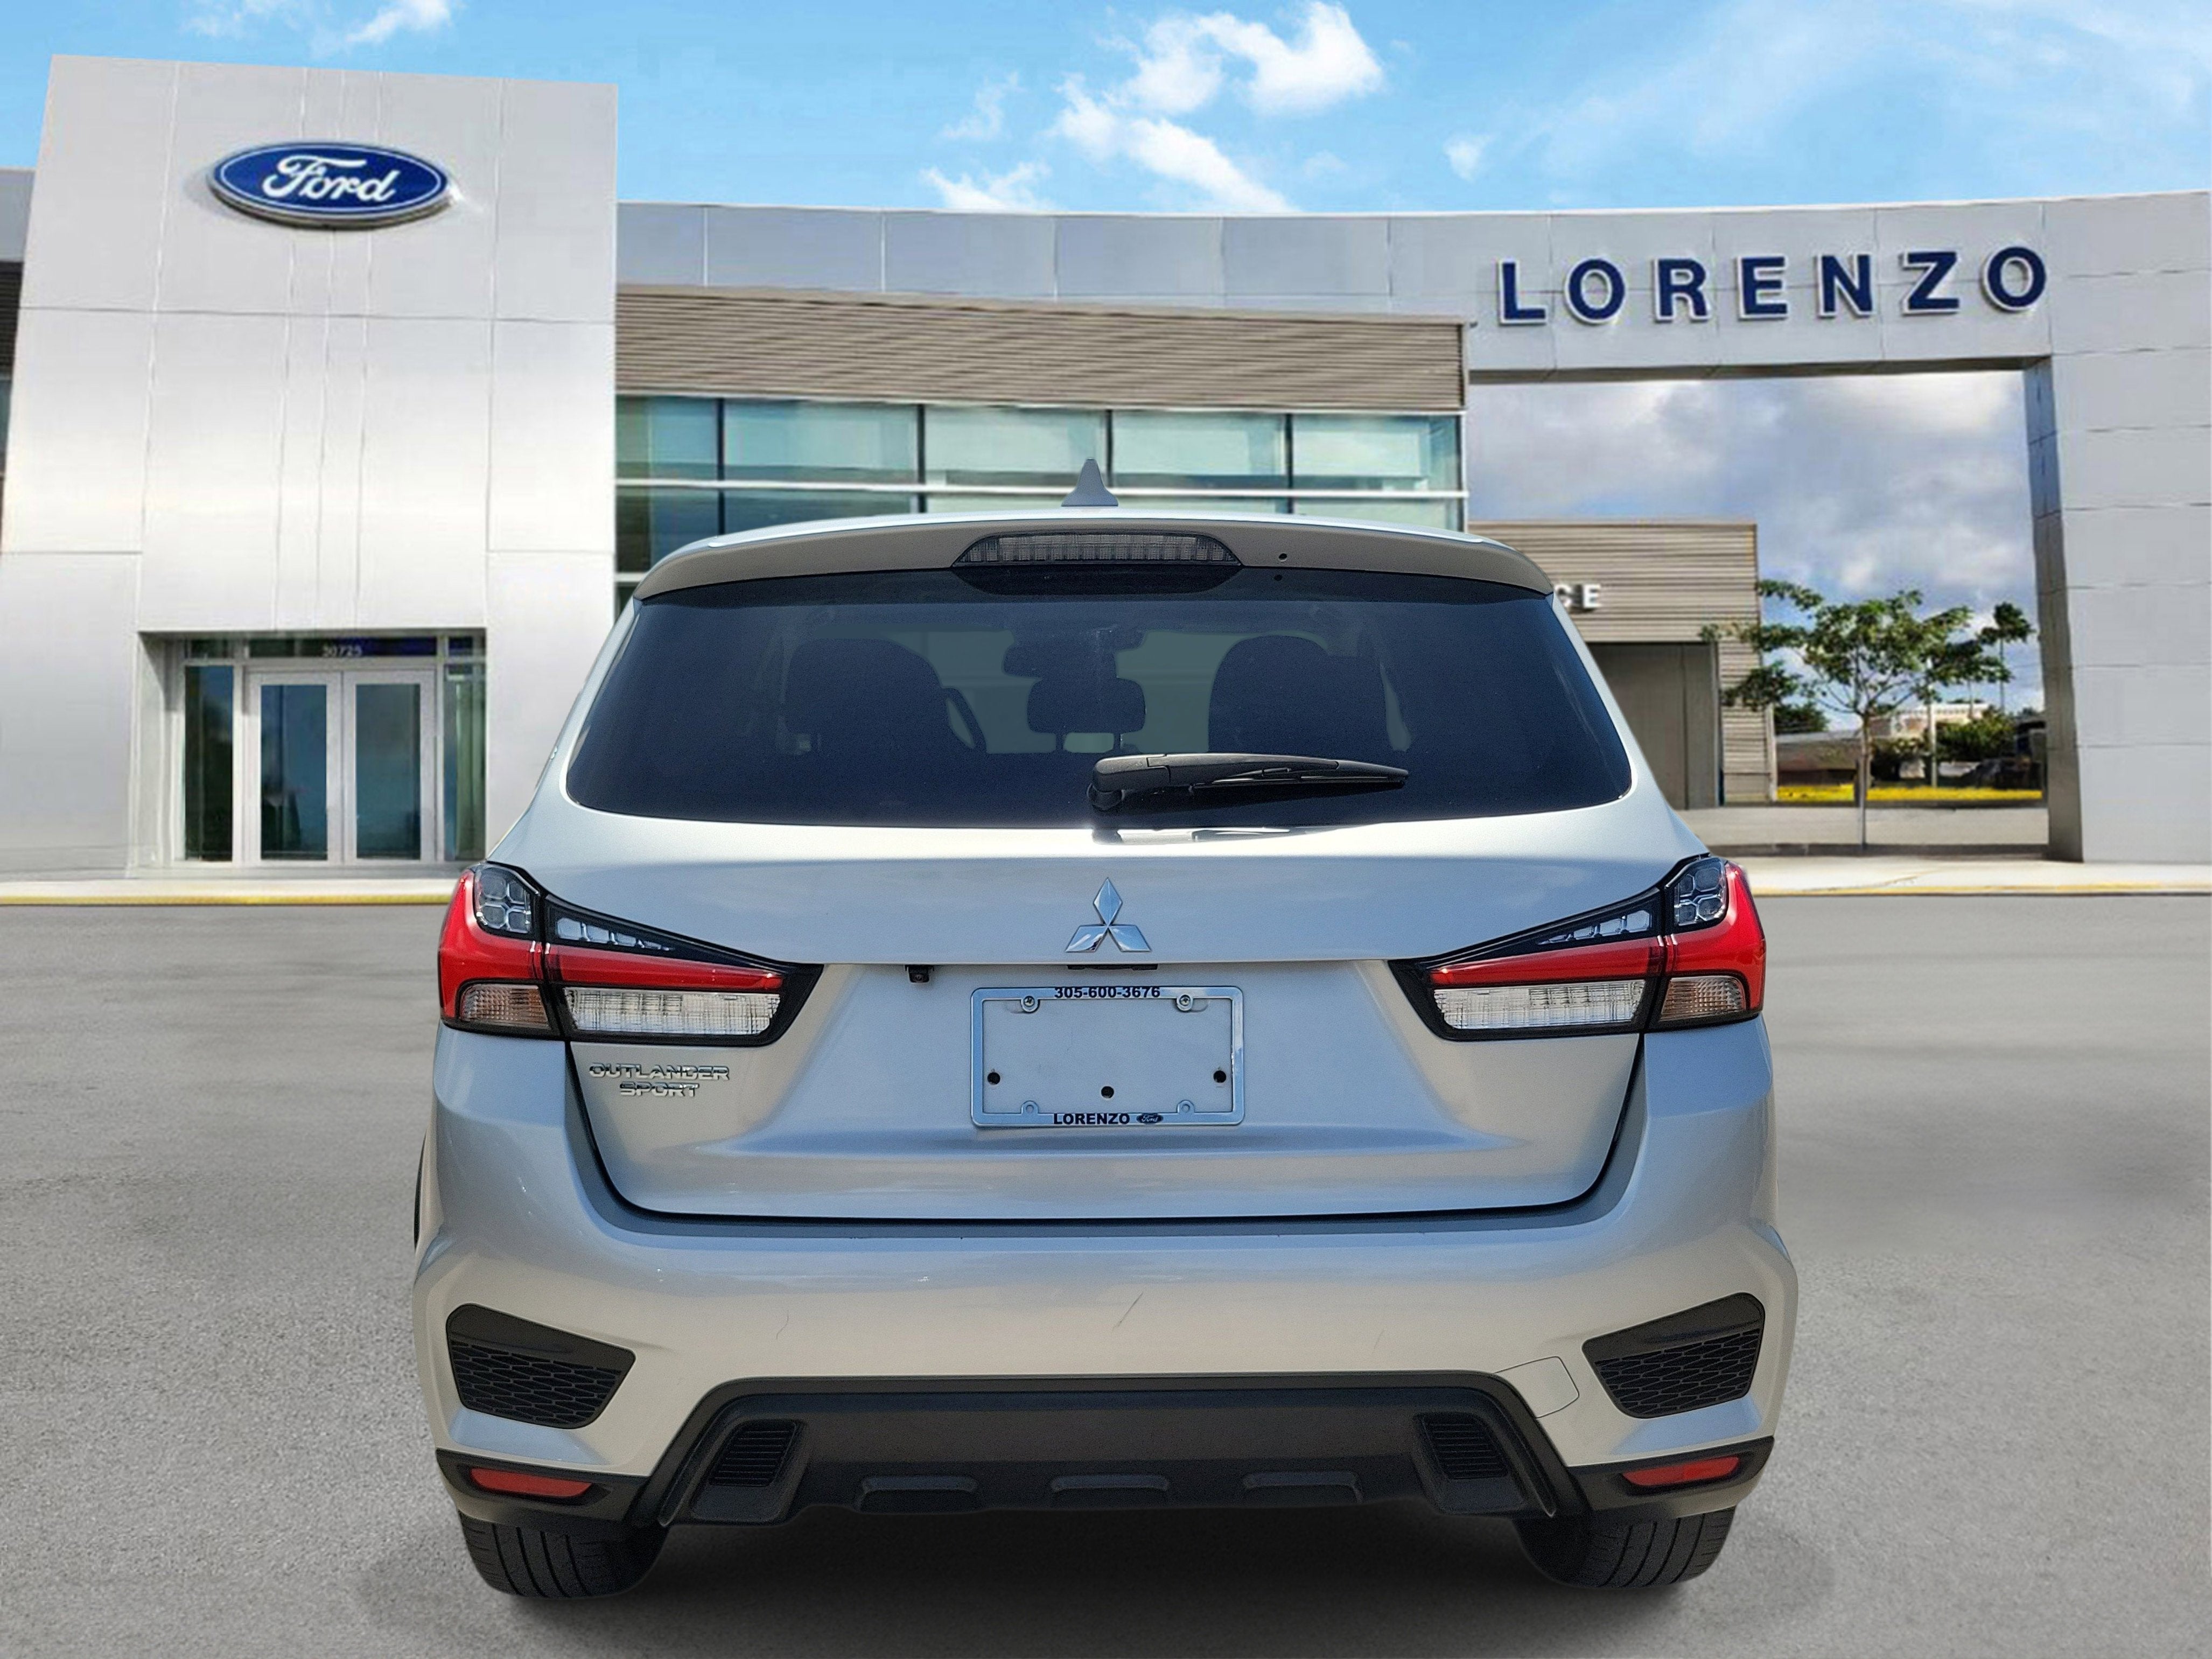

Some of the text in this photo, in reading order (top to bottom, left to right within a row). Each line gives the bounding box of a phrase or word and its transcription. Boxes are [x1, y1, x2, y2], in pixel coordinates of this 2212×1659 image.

[262, 155, 400, 201] Ford
[1497, 246, 2047, 325] LORENZO
[1054, 986, 1160, 998] 305-600-3676
[589, 1062, 730, 1080] OUTLANDER
[620, 1081, 699, 1097] SPORT
[1053, 1113, 1130, 1125] LORENZO
